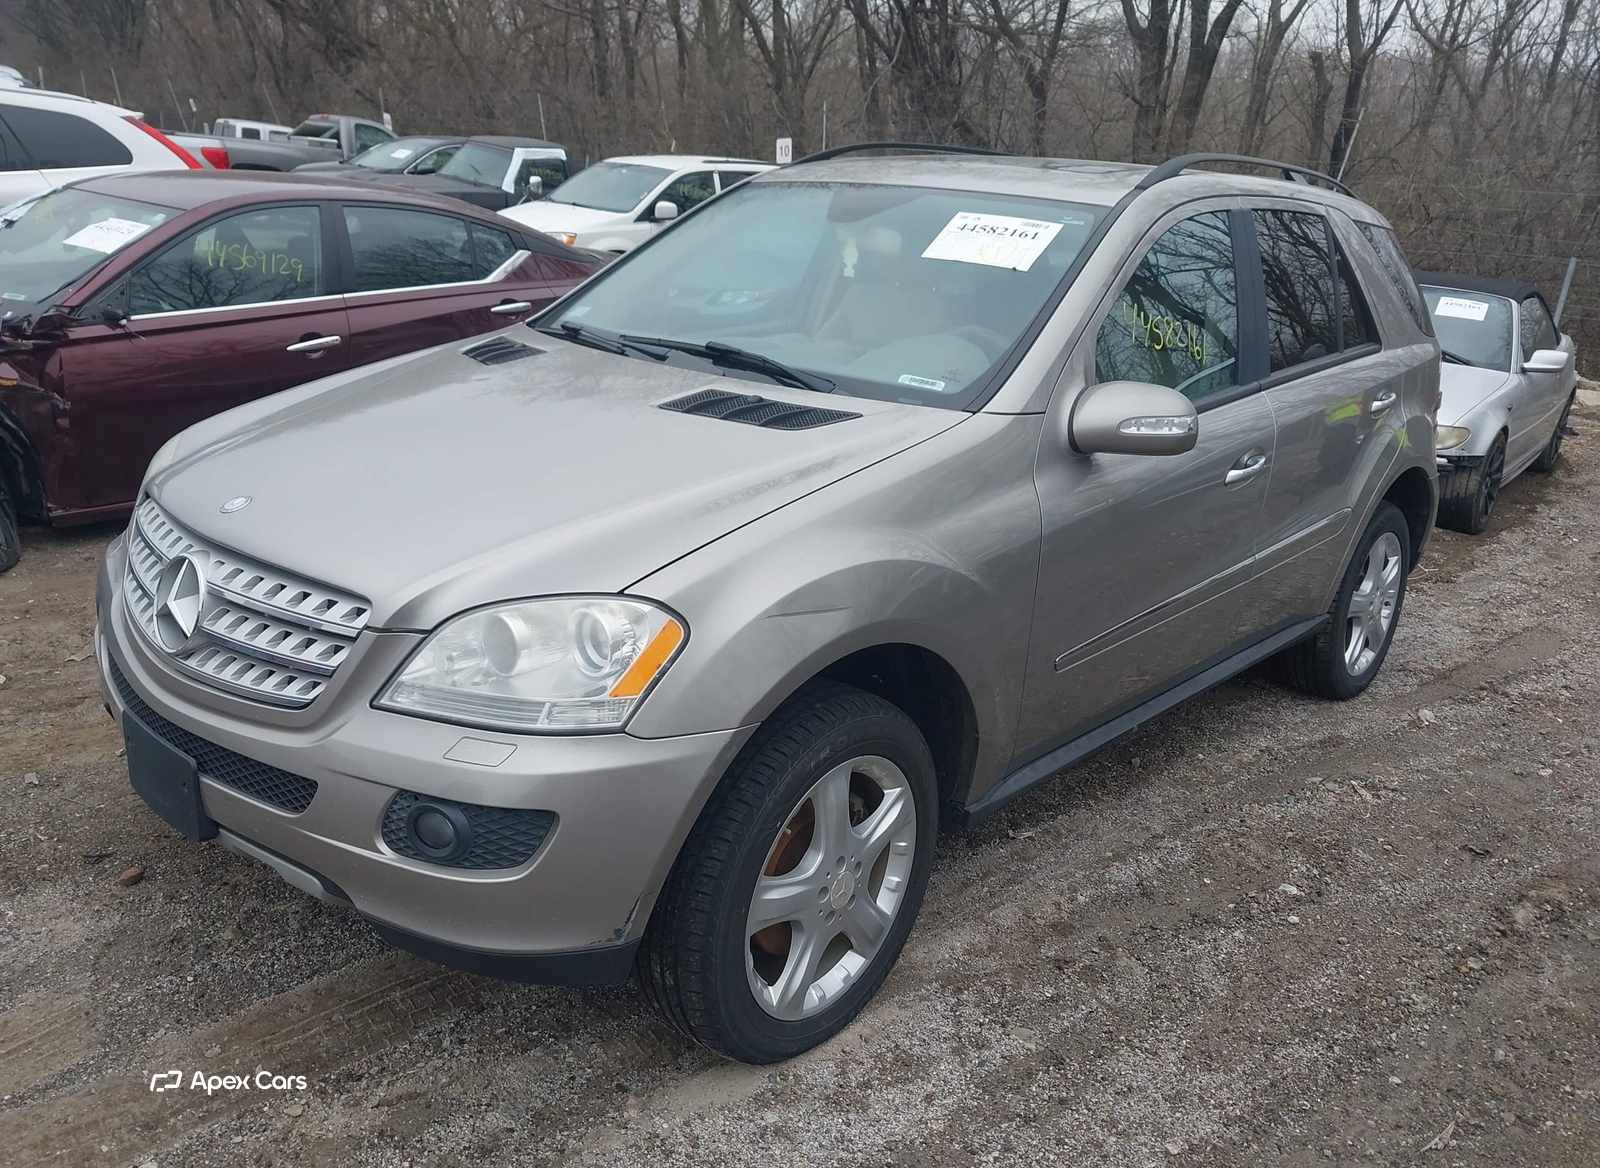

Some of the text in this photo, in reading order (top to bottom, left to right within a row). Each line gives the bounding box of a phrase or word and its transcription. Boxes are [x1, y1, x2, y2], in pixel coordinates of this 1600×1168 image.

[779, 145, 790, 157] 10
[956, 223, 1039, 240] 44582161
[194, 239, 303, 282] 44569129
[1123, 301, 1206, 366] 44582161
